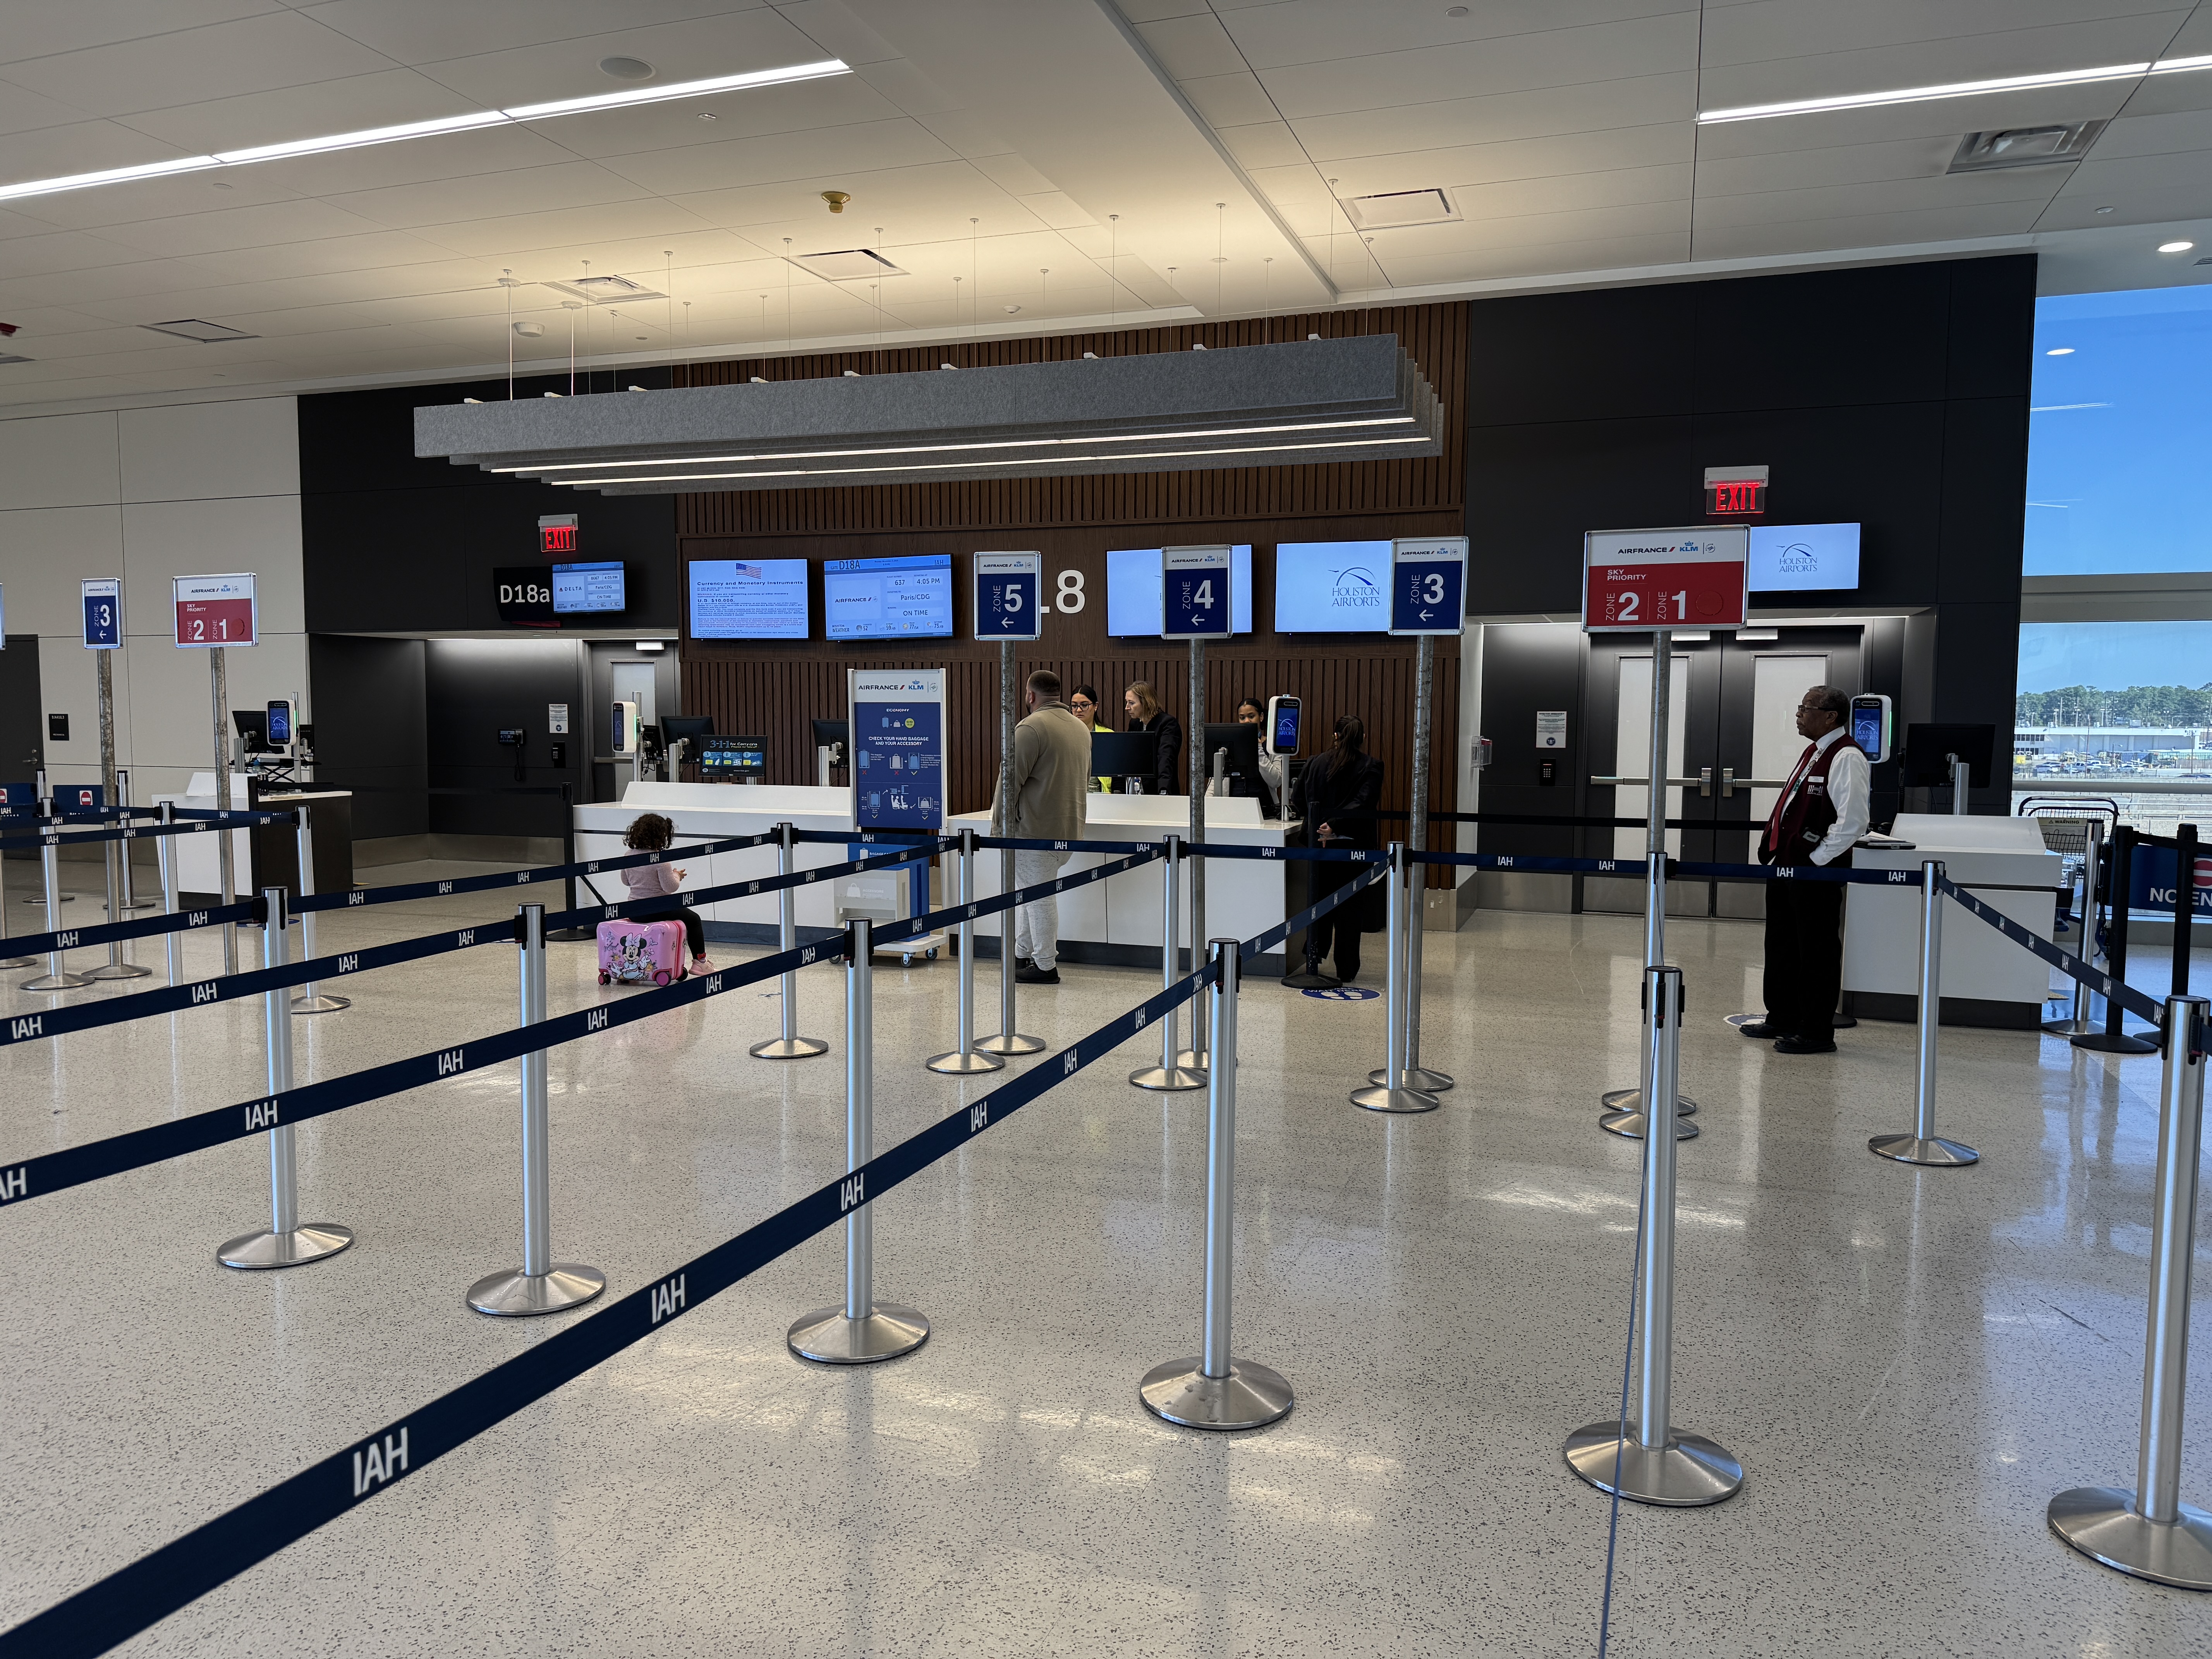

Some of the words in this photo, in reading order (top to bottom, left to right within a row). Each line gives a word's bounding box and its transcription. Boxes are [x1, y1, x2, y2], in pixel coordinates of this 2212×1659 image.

[1716, 482, 1759, 511] EXIT
[545, 527, 570, 549] EXIT
[839, 560, 860, 570] D18A
[501, 585, 550, 603] D18a
[1194, 580, 1214, 608] 4
[1333, 587, 1379, 596] HOUSTON
[1411, 575, 1420, 604] ZONE
[1424, 574, 1443, 603] 3
[1005, 585, 1022, 611] 5
[1332, 597, 1379, 606] AIRPORTS
[1606, 593, 1614, 620] ZONE
[1618, 592, 1639, 620] 2
[1657, 592, 1666, 619] ZONE
[1672, 591, 1686, 619] 1
[100, 605, 110, 626] 3
[194, 620, 204, 640] 2
[219, 619, 227, 639] 1
[46, 835, 58, 844] IAH
[125, 829, 136, 837] IAH
[1055, 841, 1067, 849] IAH
[1137, 843, 1149, 852] IAH
[1262, 848, 1275, 857] IAH
[650, 853, 659, 862] IAH
[1351, 851, 1365, 860] IAH
[1498, 856, 1513, 866] IAH
[589, 862, 598, 872] IAH
[1599, 861, 1614, 870] IAH
[1777, 867, 1793, 877] IAH
[518, 872, 529, 883] IAH
[806, 871, 814, 881] IAH
[1889, 872, 1906, 881] IAH
[440, 882, 452, 893] IAH
[750, 881, 758, 893] IAH
[349, 892, 363, 905] IAH
[683, 893, 693, 905] IAH
[189, 911, 207, 926] IAH
[606, 905, 618, 918] IAH
[913, 918, 922, 933] IAH
[57, 931, 78, 947] IAH
[459, 930, 474, 946] IAH
[339, 954, 357, 972] IAH
[802, 947, 815, 964] IAH
[707, 974, 721, 994] IAH
[1193, 974, 1202, 992] IAH
[192, 982, 217, 1003] IAH
[588, 1008, 607, 1030] IAH
[1136, 1007, 1145, 1029] IAH
[12, 1016, 42, 1039] IAH
[439, 1049, 463, 1075] IAH
[1065, 1049, 1077, 1074] IAH
[246, 1100, 277, 1130] IAH
[971, 1101, 987, 1132] IAH
[841, 1173, 863, 1211] IAH
[652, 1274, 685, 1323] IAH
[354, 1427, 407, 1496] IAH
